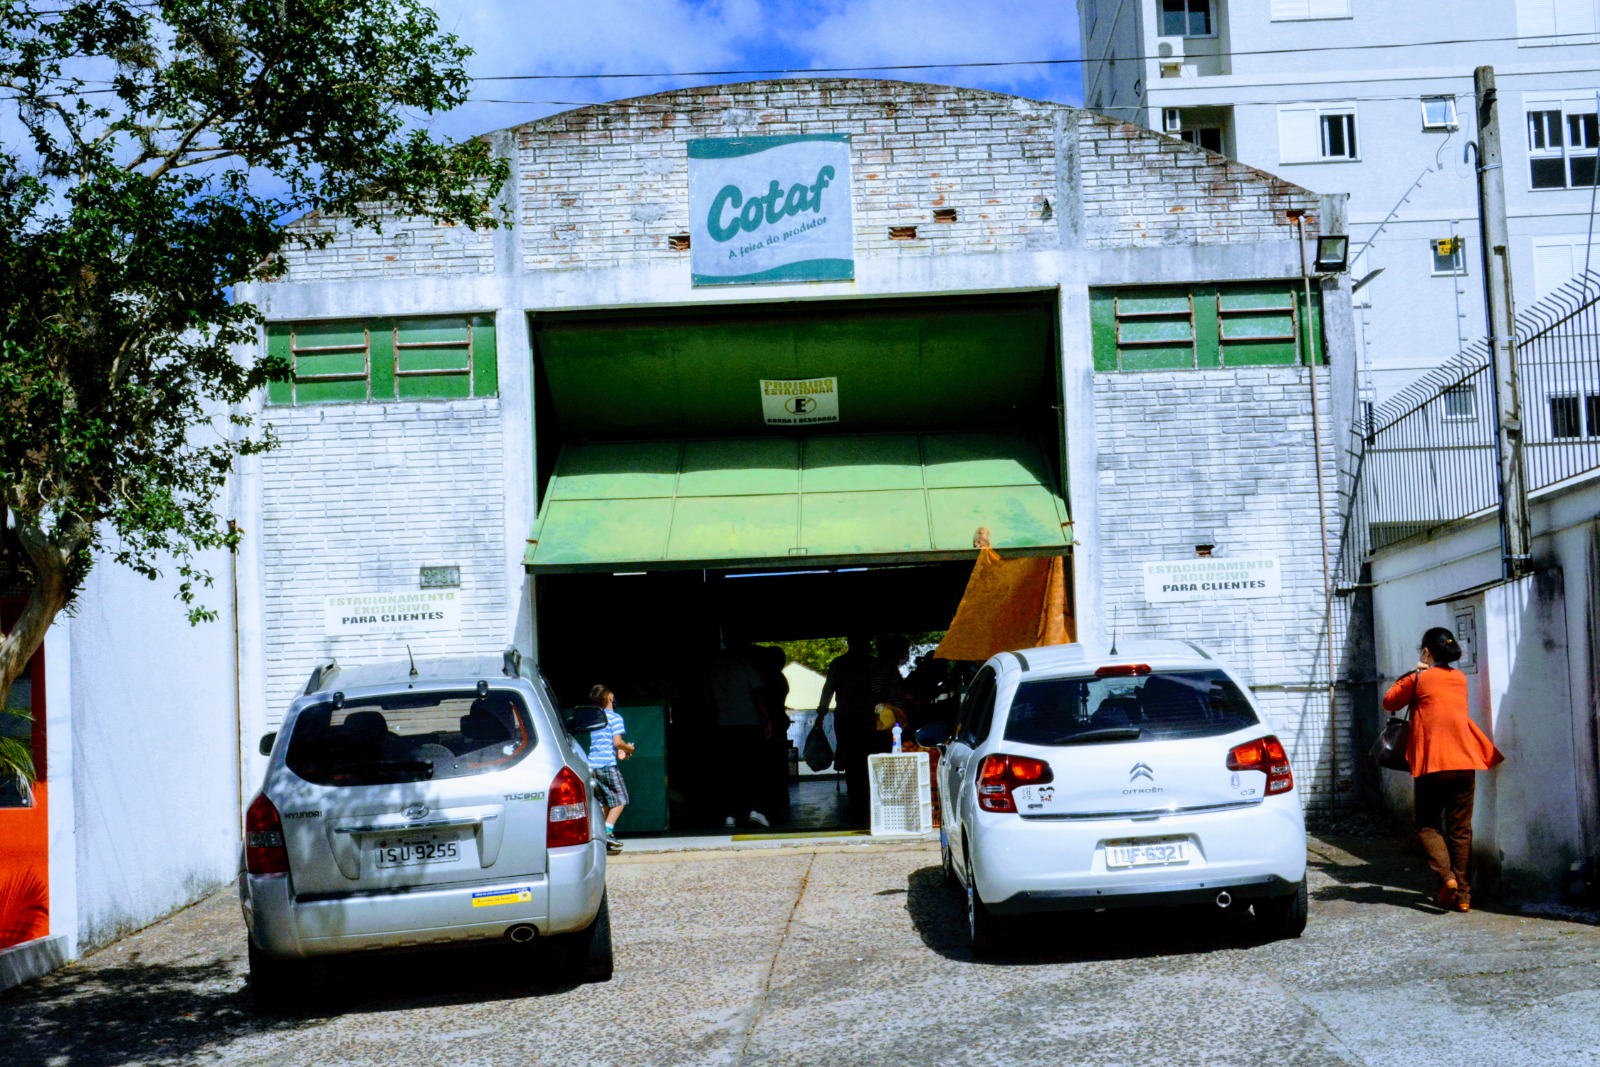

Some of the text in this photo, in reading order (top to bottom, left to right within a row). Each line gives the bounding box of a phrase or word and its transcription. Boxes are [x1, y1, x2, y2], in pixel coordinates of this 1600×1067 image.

[707, 165, 835, 242] Cotaf
[728, 216, 827, 260] A feira do produtor
[764, 387, 833, 396] ESTACIONAR
[795, 398, 807, 413] E
[1148, 560, 1274, 574] ESTACIONAMENTO
[1172, 571, 1249, 582] EXCLUSIVO
[1162, 580, 1266, 592] PARA CLIENTES
[329, 592, 455, 606] ESTACIONAMENTO
[354, 604, 431, 615] EXCLUSIVO
[342, 611, 444, 624] PARA CLIENTES
[503, 791, 545, 801] TUCSON
[284, 810, 323, 820] HYUNDAI
